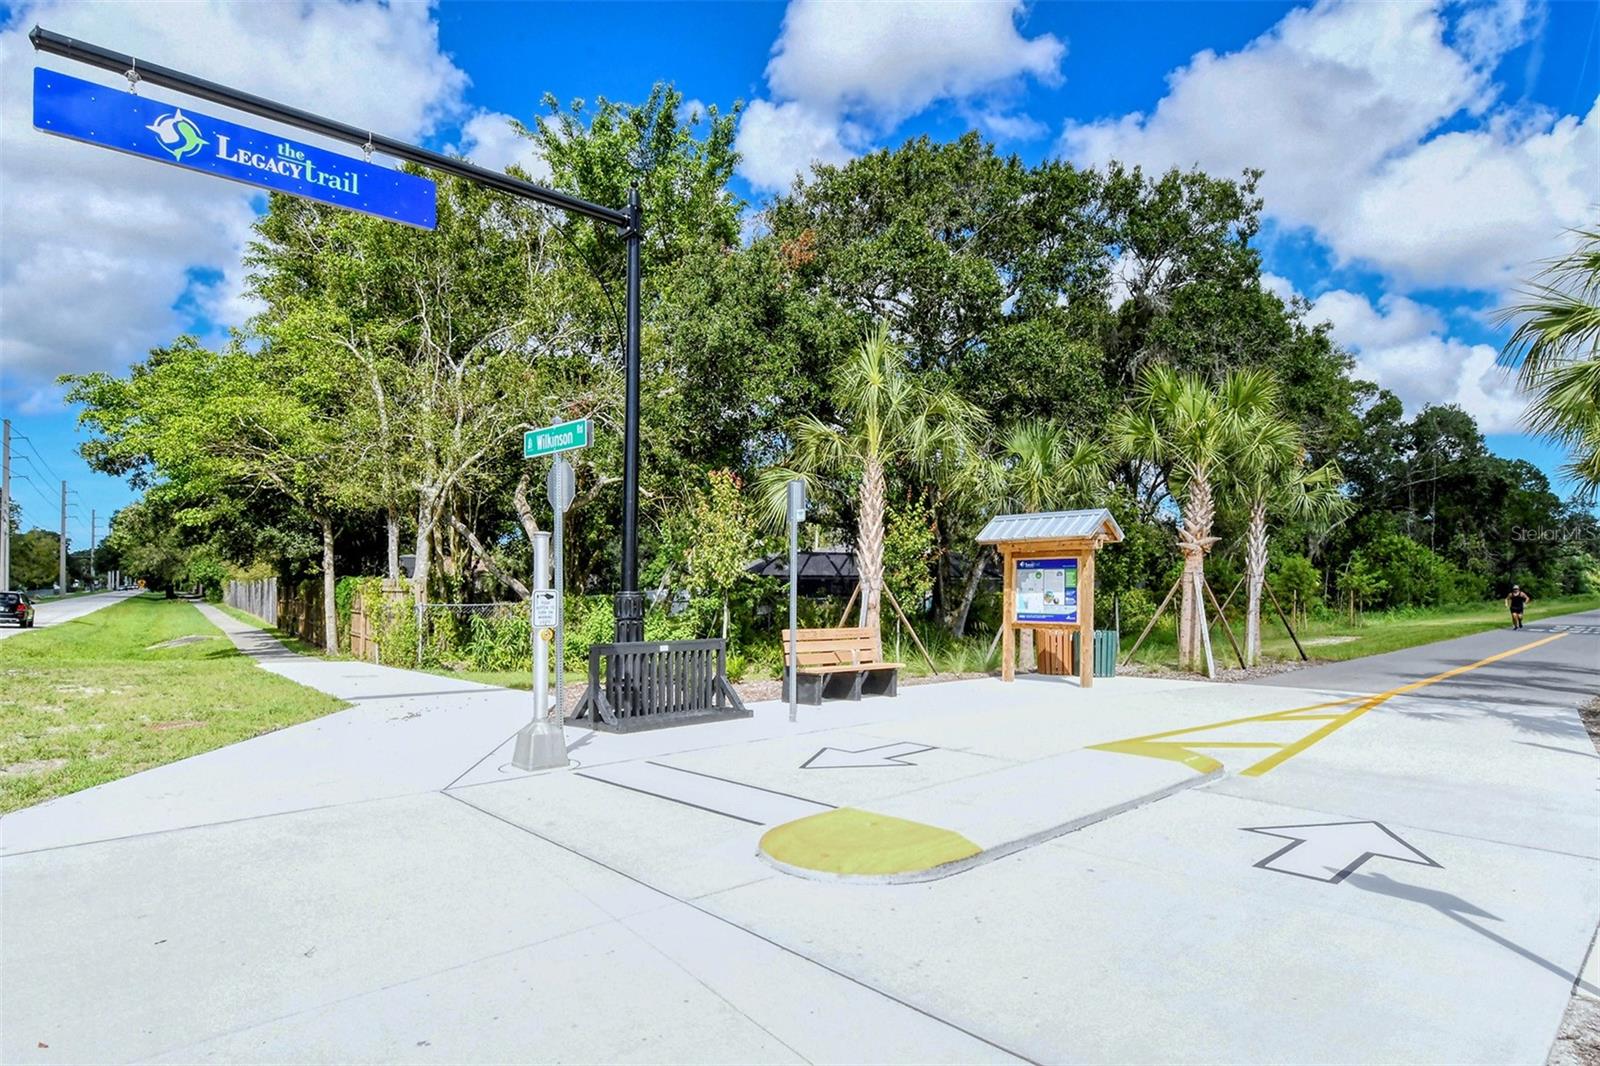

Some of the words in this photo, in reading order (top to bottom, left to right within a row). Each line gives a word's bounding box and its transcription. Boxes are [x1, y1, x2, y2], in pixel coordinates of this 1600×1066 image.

[277, 142, 305, 160] the
[215, 134, 303, 180] LEGACY
[305, 160, 360, 195] trail
[536, 431, 574, 451] Wilkinson
